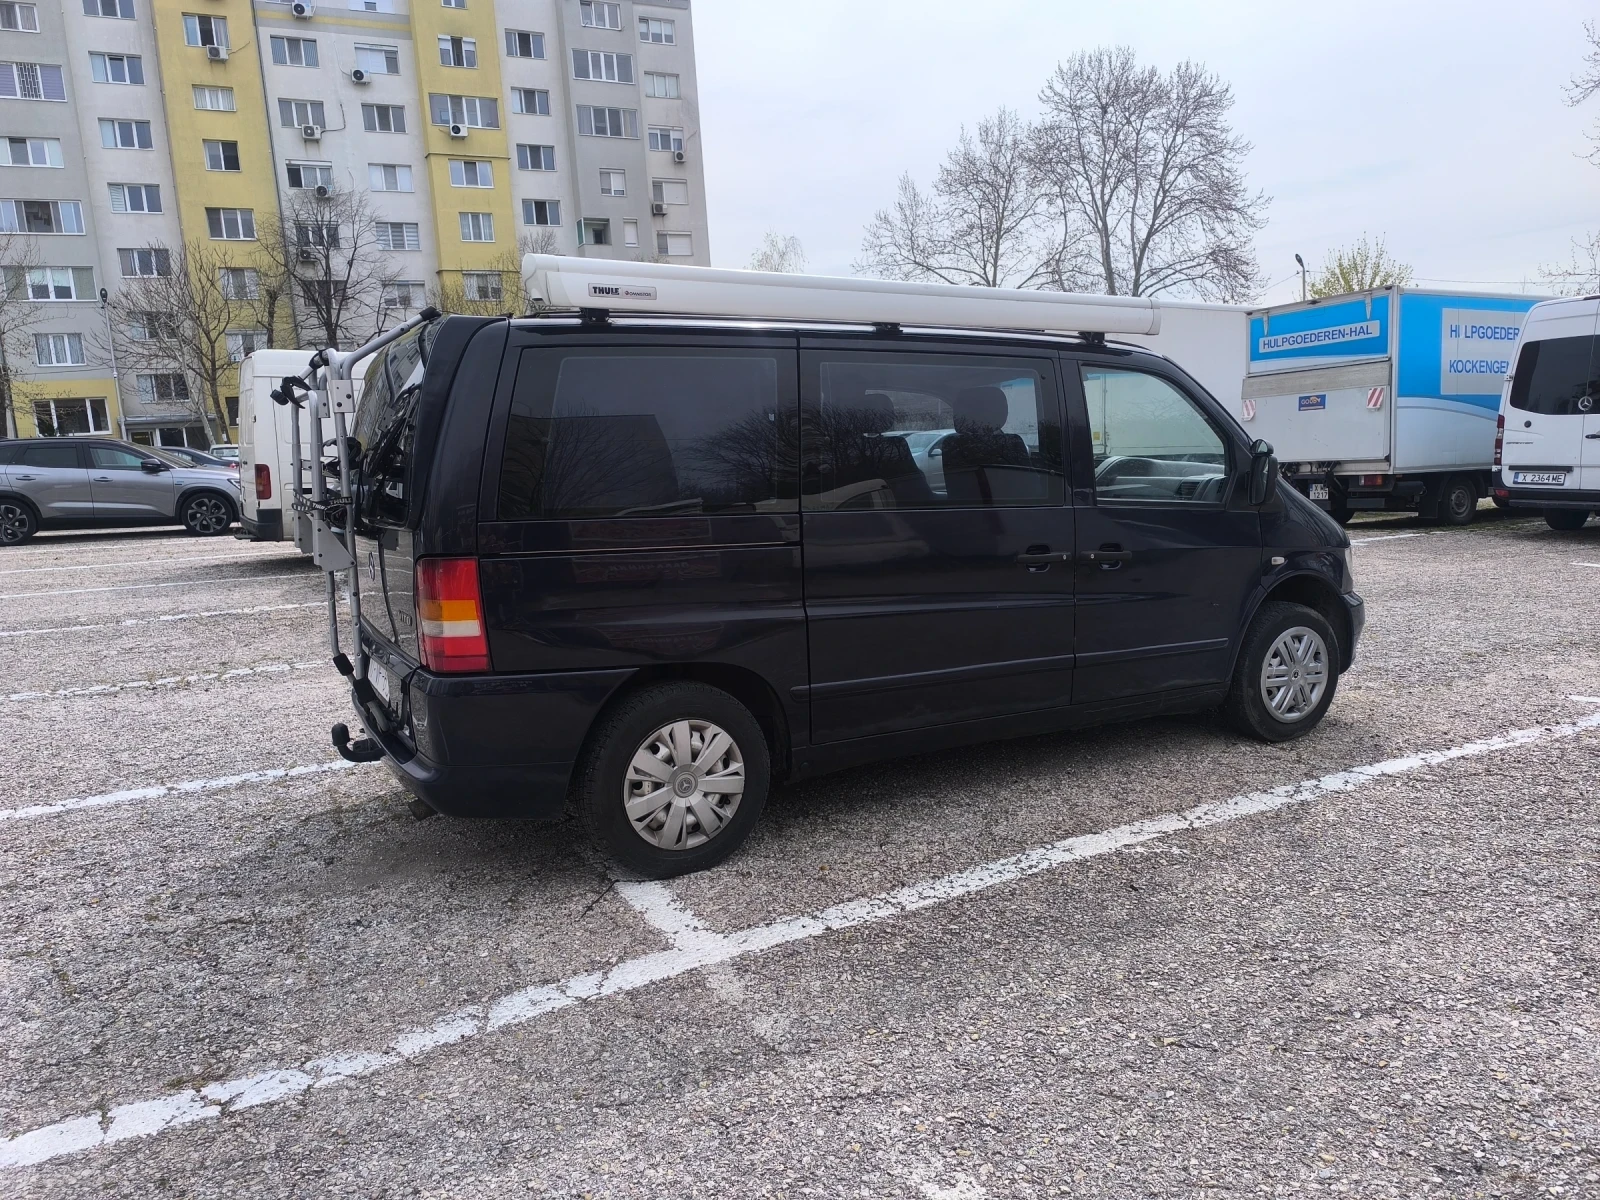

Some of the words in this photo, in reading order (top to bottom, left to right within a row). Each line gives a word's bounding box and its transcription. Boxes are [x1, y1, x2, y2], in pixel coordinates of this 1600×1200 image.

[592, 286, 620, 296] THULE
[1263, 325, 1373, 349] HULPGOEDEREN-HAL
[1530, 474, 1551, 482] 2364
[1551, 475, 1564, 483] ME
